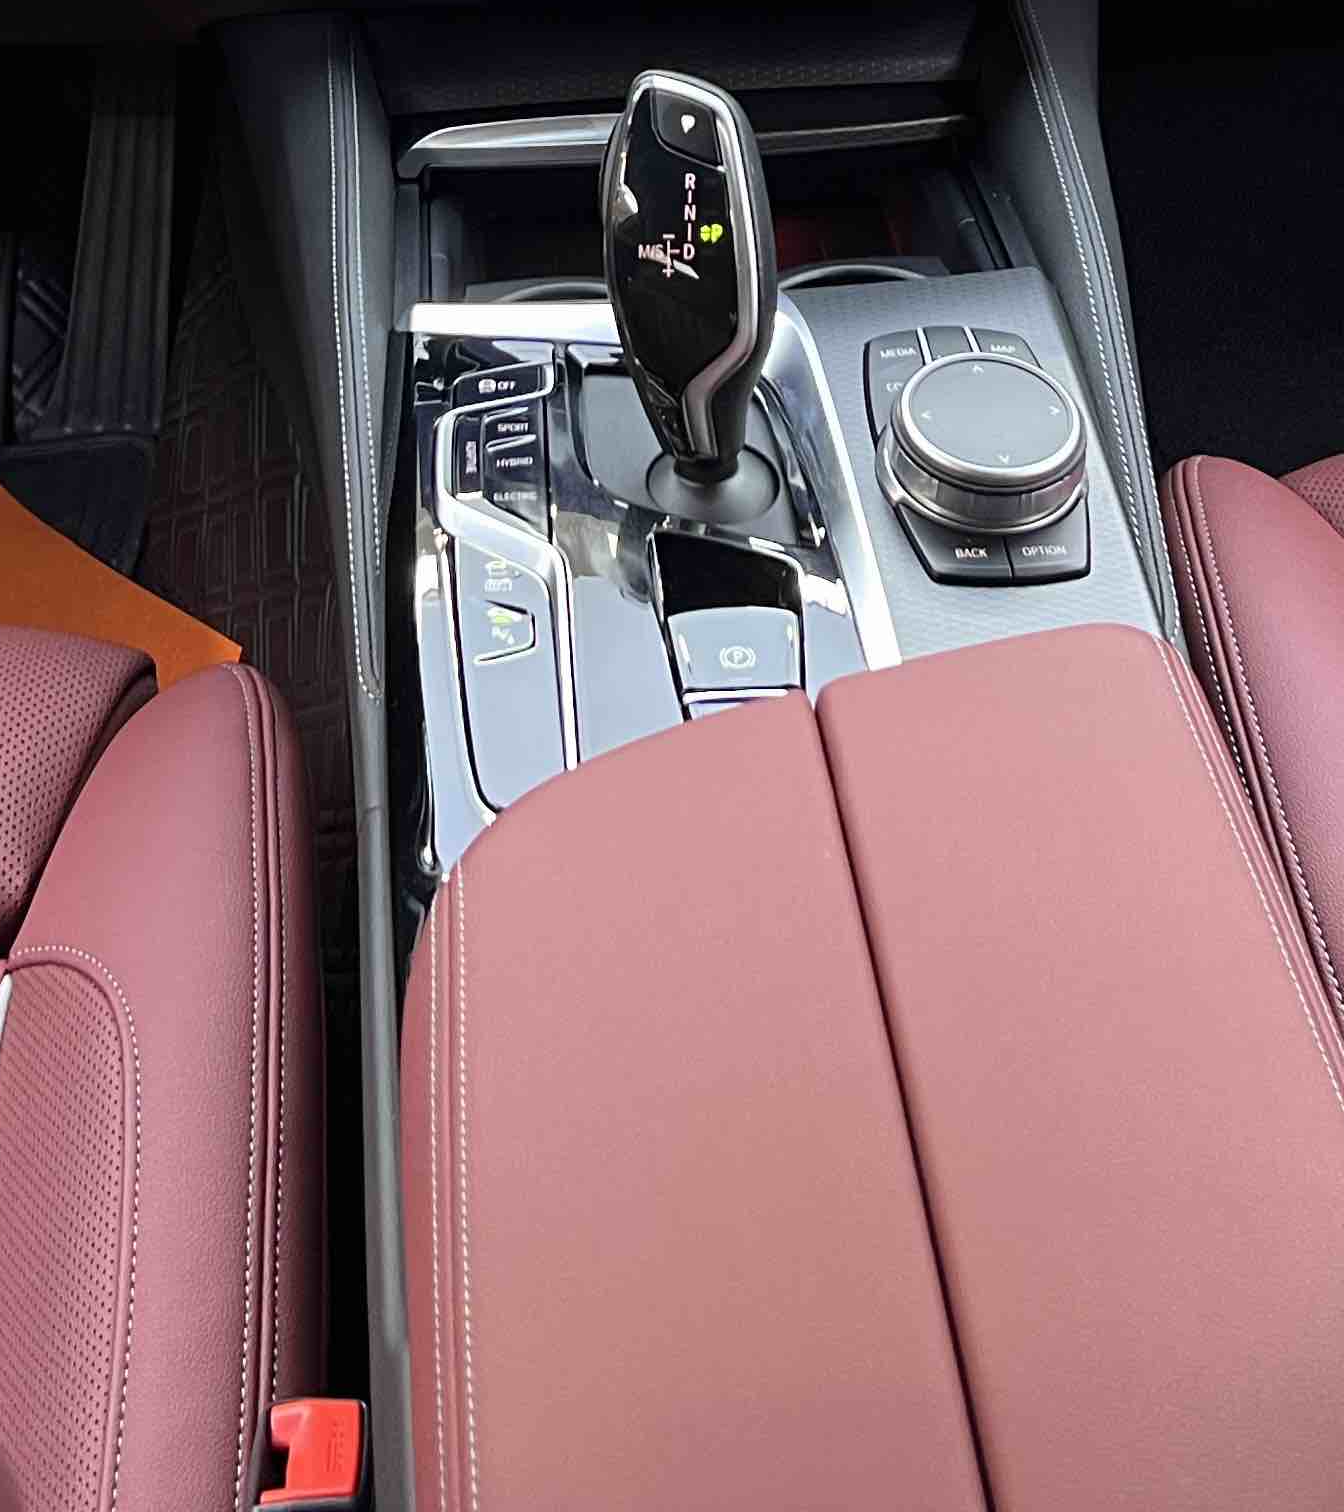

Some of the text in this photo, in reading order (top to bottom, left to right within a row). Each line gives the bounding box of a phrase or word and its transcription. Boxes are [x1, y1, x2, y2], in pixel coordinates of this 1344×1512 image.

[685, 173, 697, 190] R
[684, 205, 697, 222] N
[683, 243, 696, 260] D
[880, 346, 917, 359] MEDIA
[990, 344, 1017, 354] MAP
[498, 380, 517, 391] OFF
[497, 422, 529, 433] SPORT
[496, 456, 534, 468] HYBRID
[493, 491, 538, 502] ELECTRIC
[955, 547, 989, 559] BACK
[1022, 545, 1067, 558] OPTION
